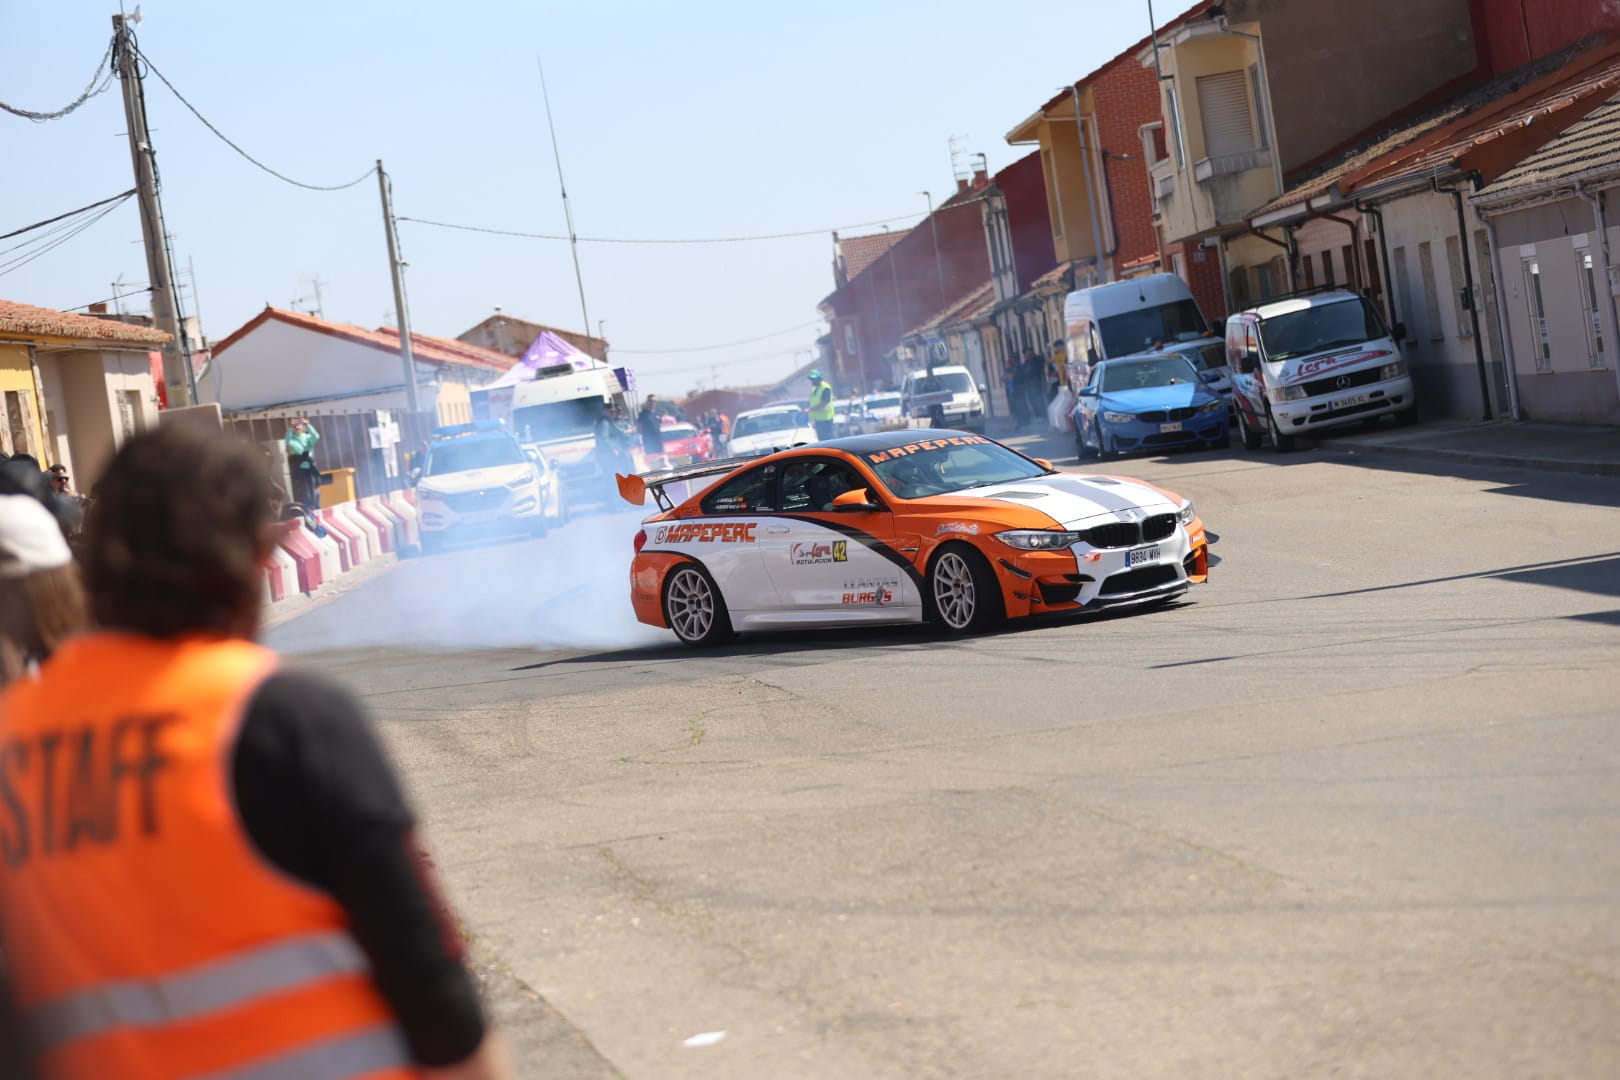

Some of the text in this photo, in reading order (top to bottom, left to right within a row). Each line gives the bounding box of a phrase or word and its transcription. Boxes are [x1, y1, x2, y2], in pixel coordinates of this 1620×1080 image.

[665, 523, 758, 543] MAPEPERC
[833, 542, 847, 561] 42
[0, 712, 184, 871] STAFF
